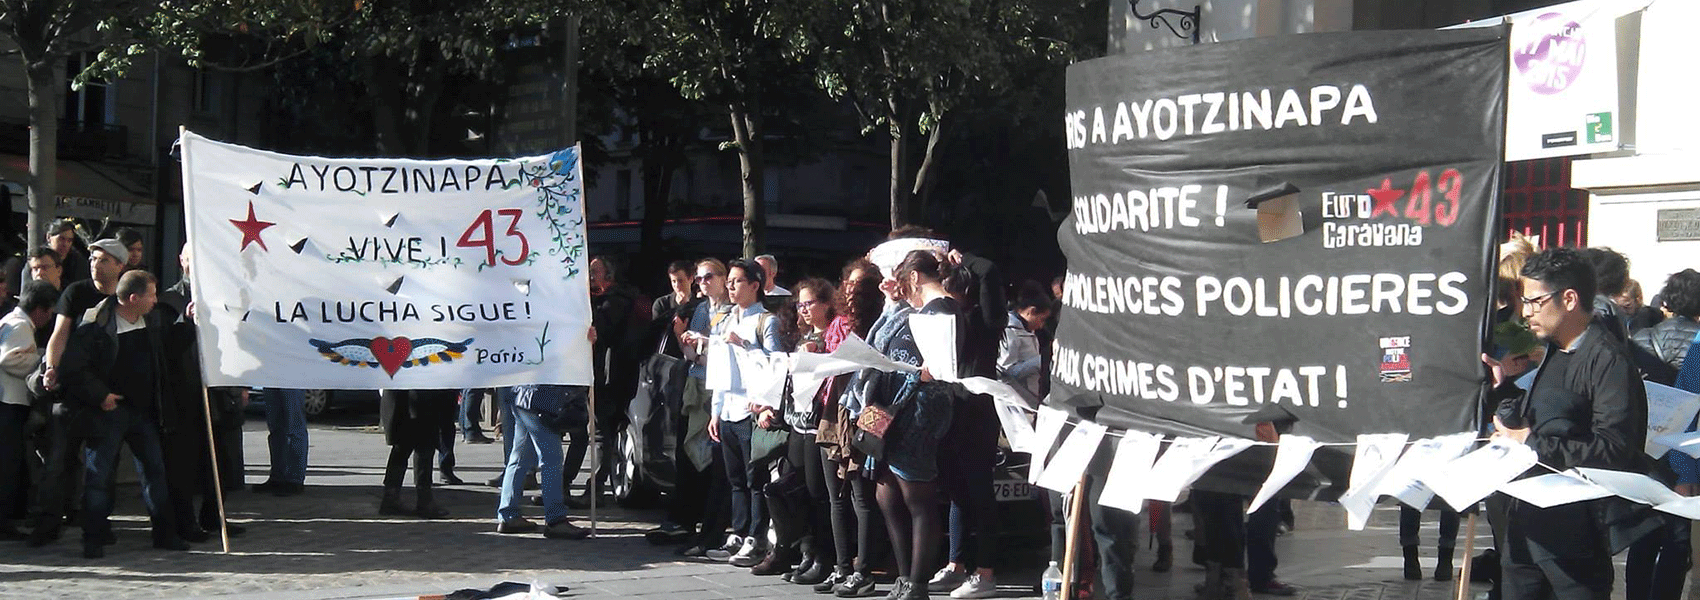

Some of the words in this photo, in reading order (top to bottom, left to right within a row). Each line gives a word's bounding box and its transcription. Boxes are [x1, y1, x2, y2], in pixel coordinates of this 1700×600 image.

[1092, 106, 1107, 144] A
[1112, 83, 1378, 145] AYOTZINAPA
[287, 163, 508, 193] AYOTZINAPA
[1404, 167, 1463, 227] 43
[1074, 184, 1202, 235] SOLIDARITE
[349, 236, 423, 263] VIVE
[456, 208, 530, 267] 43
[275, 301, 309, 324] LA
[321, 301, 420, 324] LUCHA
[1196, 271, 1469, 319] POLICIERES
[1083, 353, 1179, 402] CRIMES
[1187, 365, 1326, 408] D'ETAT
